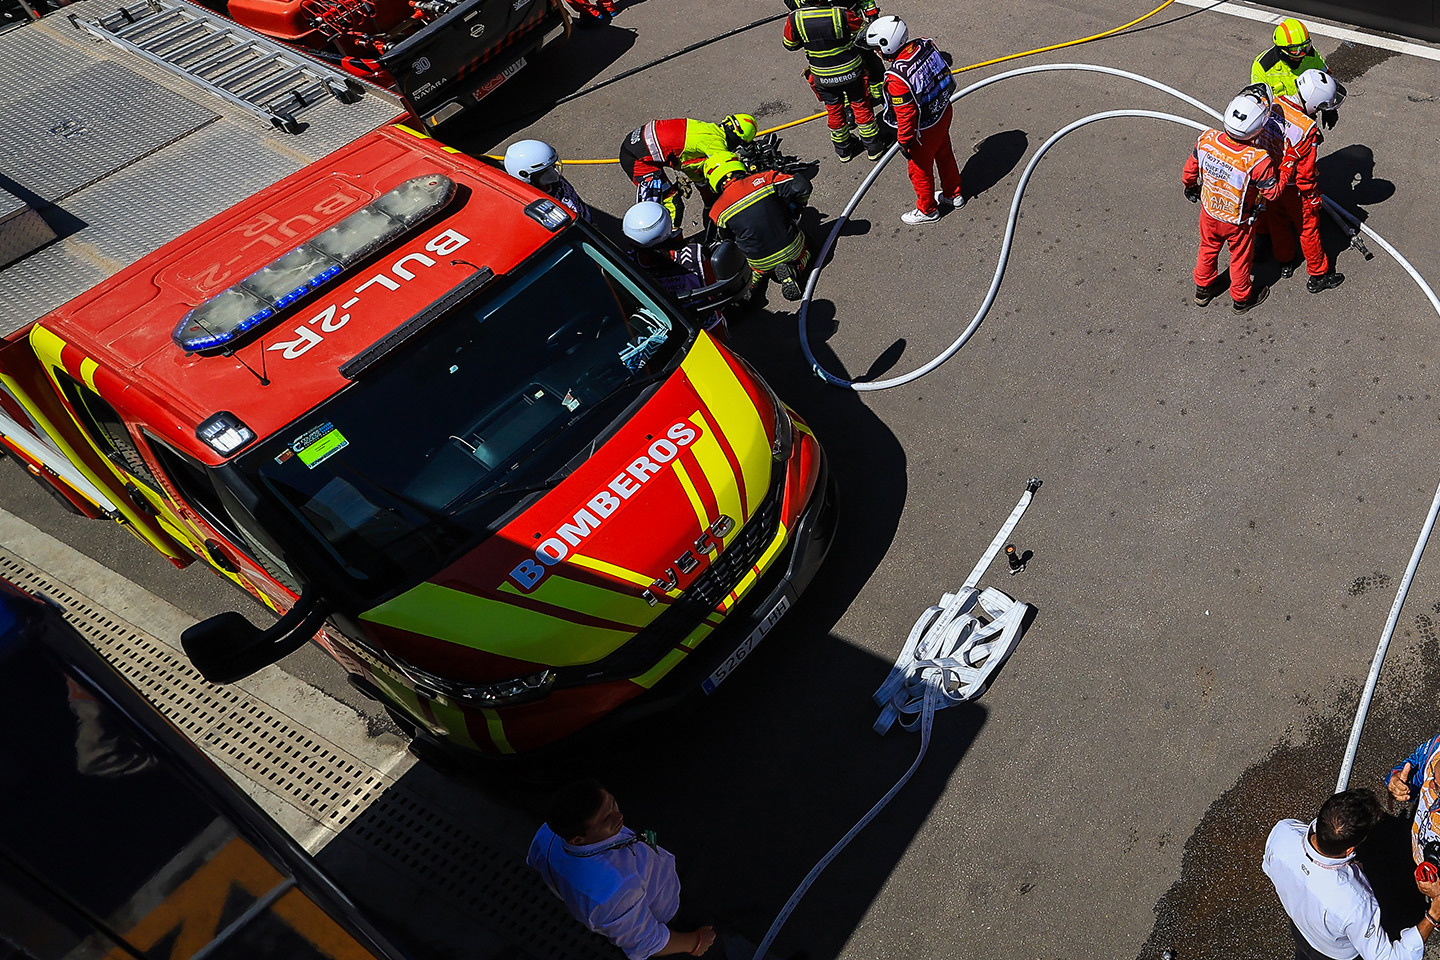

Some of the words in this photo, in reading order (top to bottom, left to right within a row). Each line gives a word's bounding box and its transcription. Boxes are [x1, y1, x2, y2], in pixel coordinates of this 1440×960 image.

[411, 56, 431, 76] 30
[413, 77, 448, 102] NAVARA
[819, 71, 858, 85] BOMBEROS
[266, 228, 471, 360] BUL-2R
[510, 418, 703, 594] BOMBEROS
[642, 513, 734, 607] IVECO
[715, 637, 754, 682] 5267
[758, 600, 788, 637] LHH
